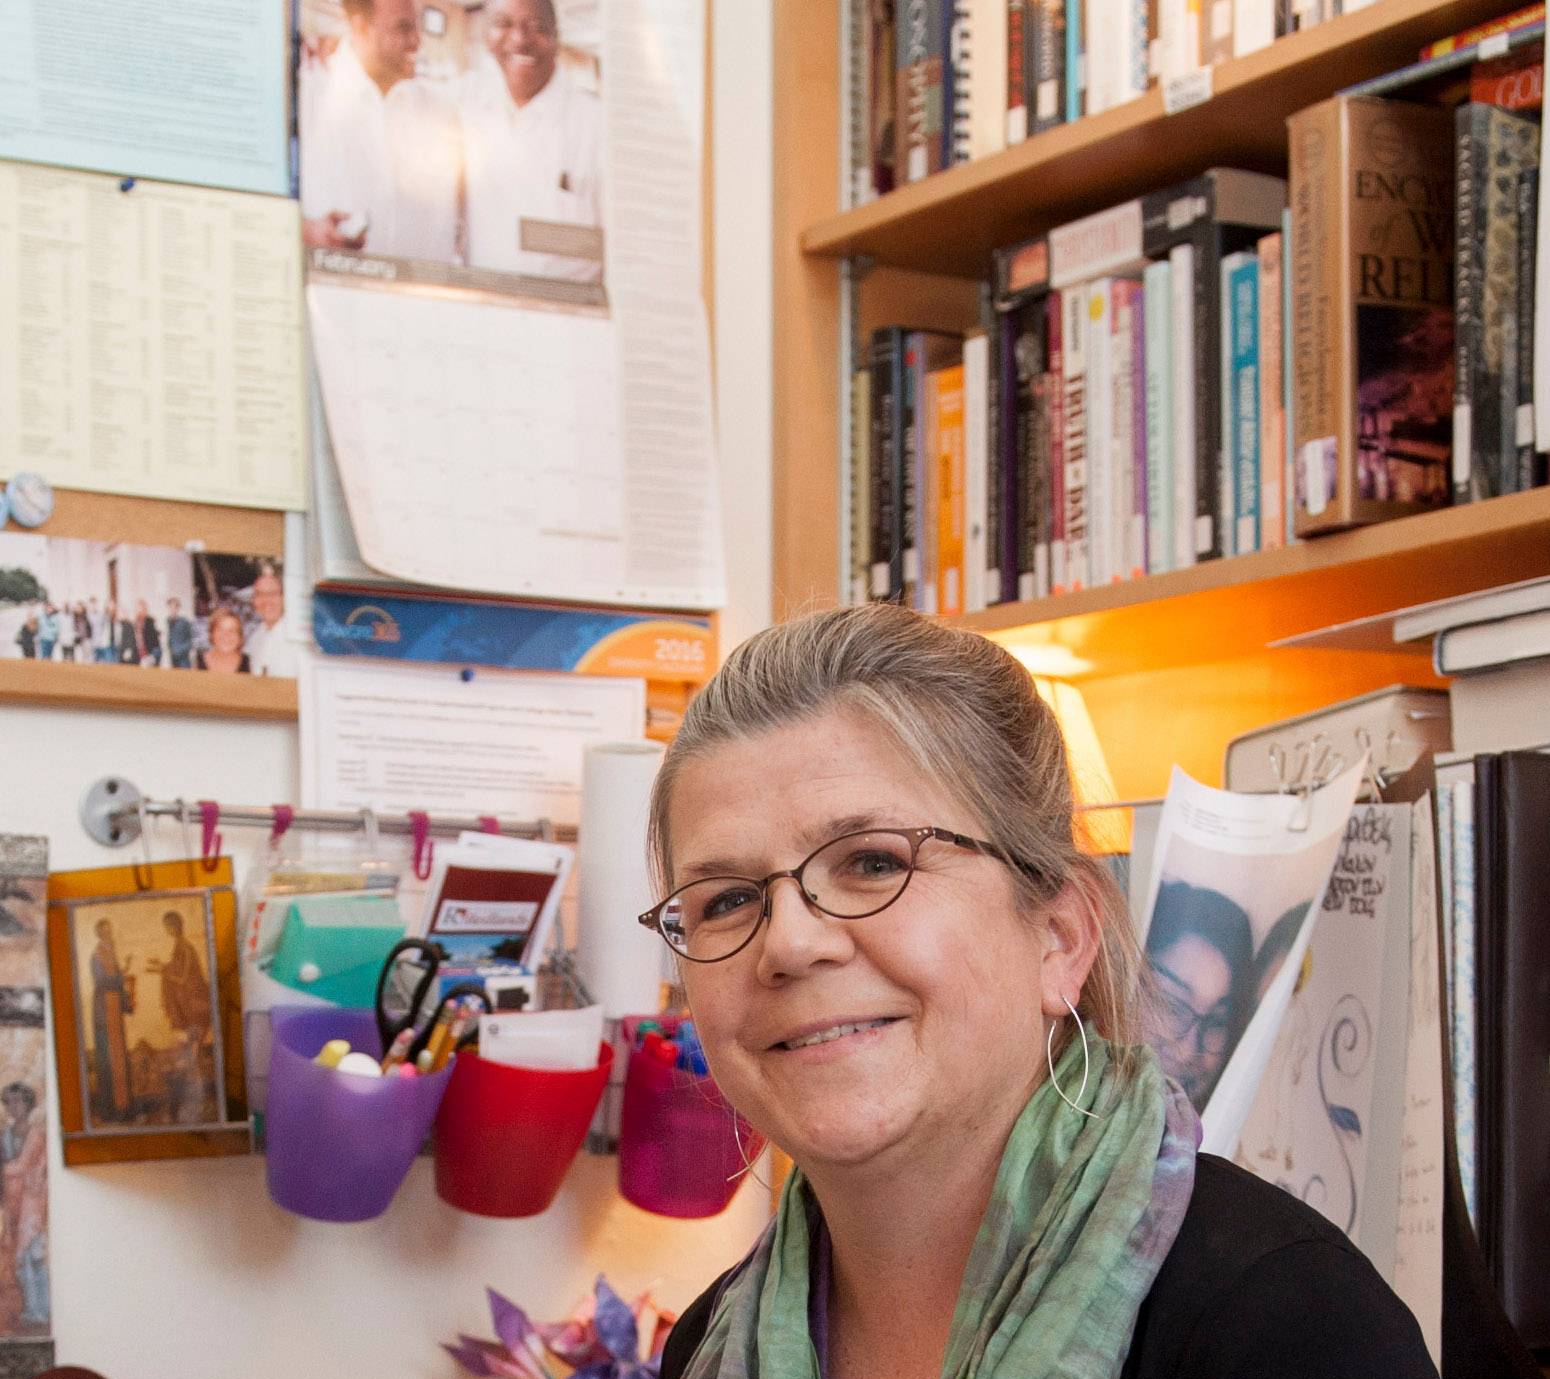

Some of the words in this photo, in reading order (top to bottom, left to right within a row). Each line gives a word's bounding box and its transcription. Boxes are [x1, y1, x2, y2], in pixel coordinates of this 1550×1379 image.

[1457, 133, 1473, 226] SACRED
[314, 250, 398, 280] February
[1457, 235, 1473, 325] TRACKS
[655, 638, 705, 661] 2016
